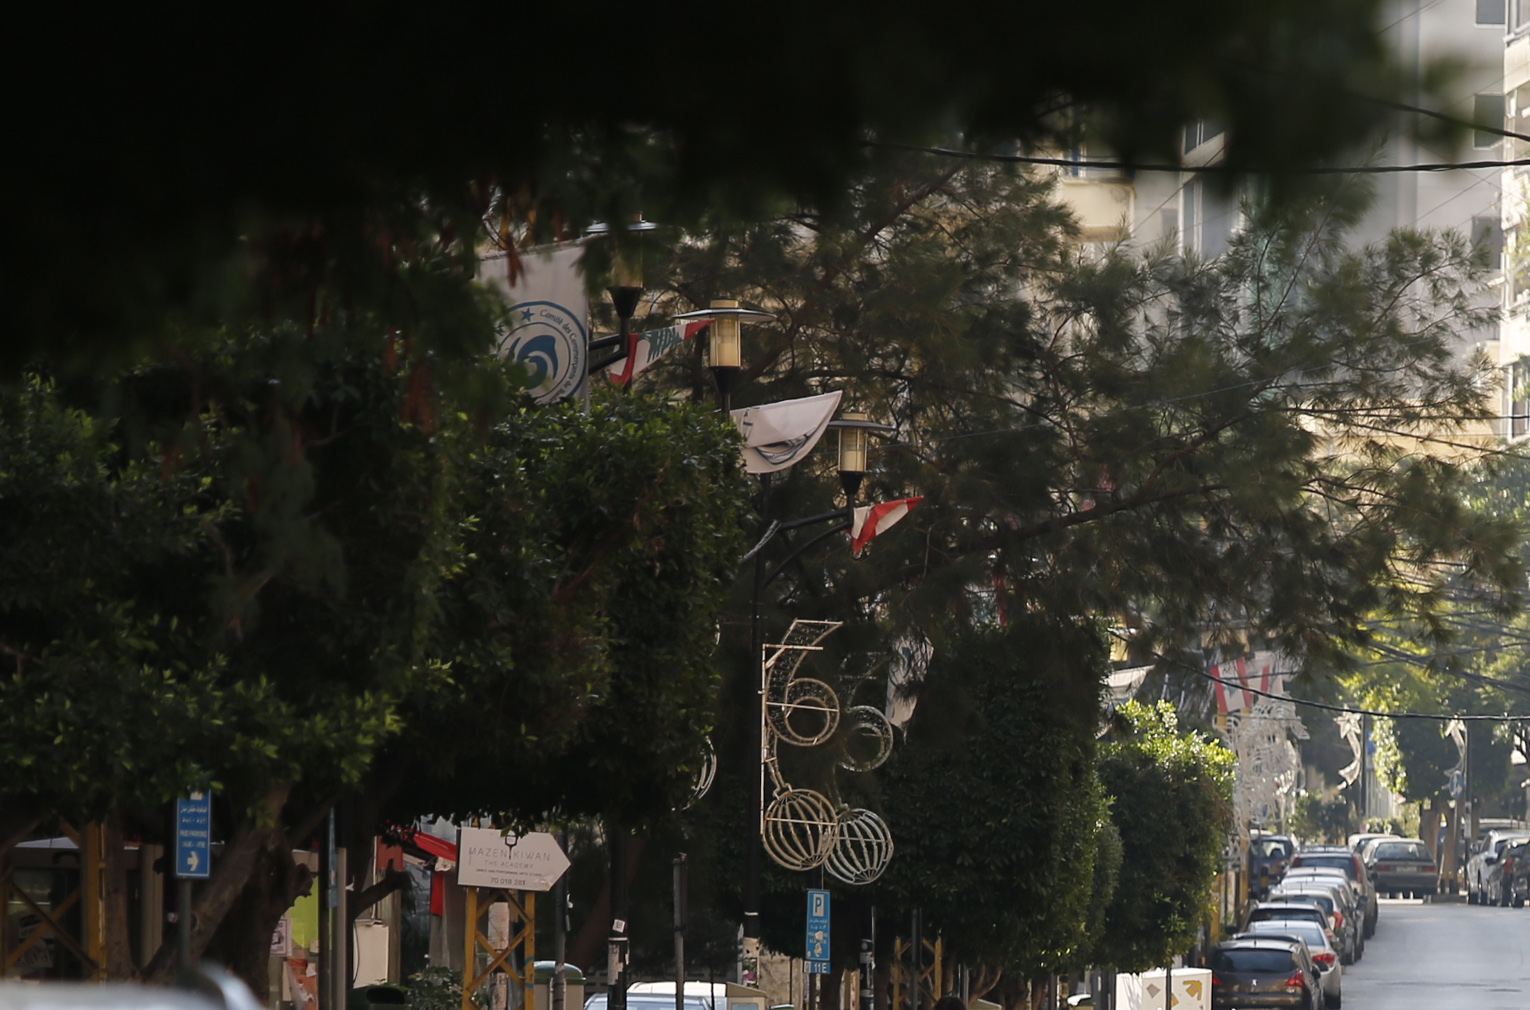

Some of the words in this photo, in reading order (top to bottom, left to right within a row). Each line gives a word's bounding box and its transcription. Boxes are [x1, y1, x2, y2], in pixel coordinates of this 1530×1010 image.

[540, 309, 563, 325] Comité
[562, 322, 571, 334] des
[468, 847, 507, 858] MAZEN
[514, 850, 550, 861] KIWAN
[500, 861, 534, 869] ACADEMY
